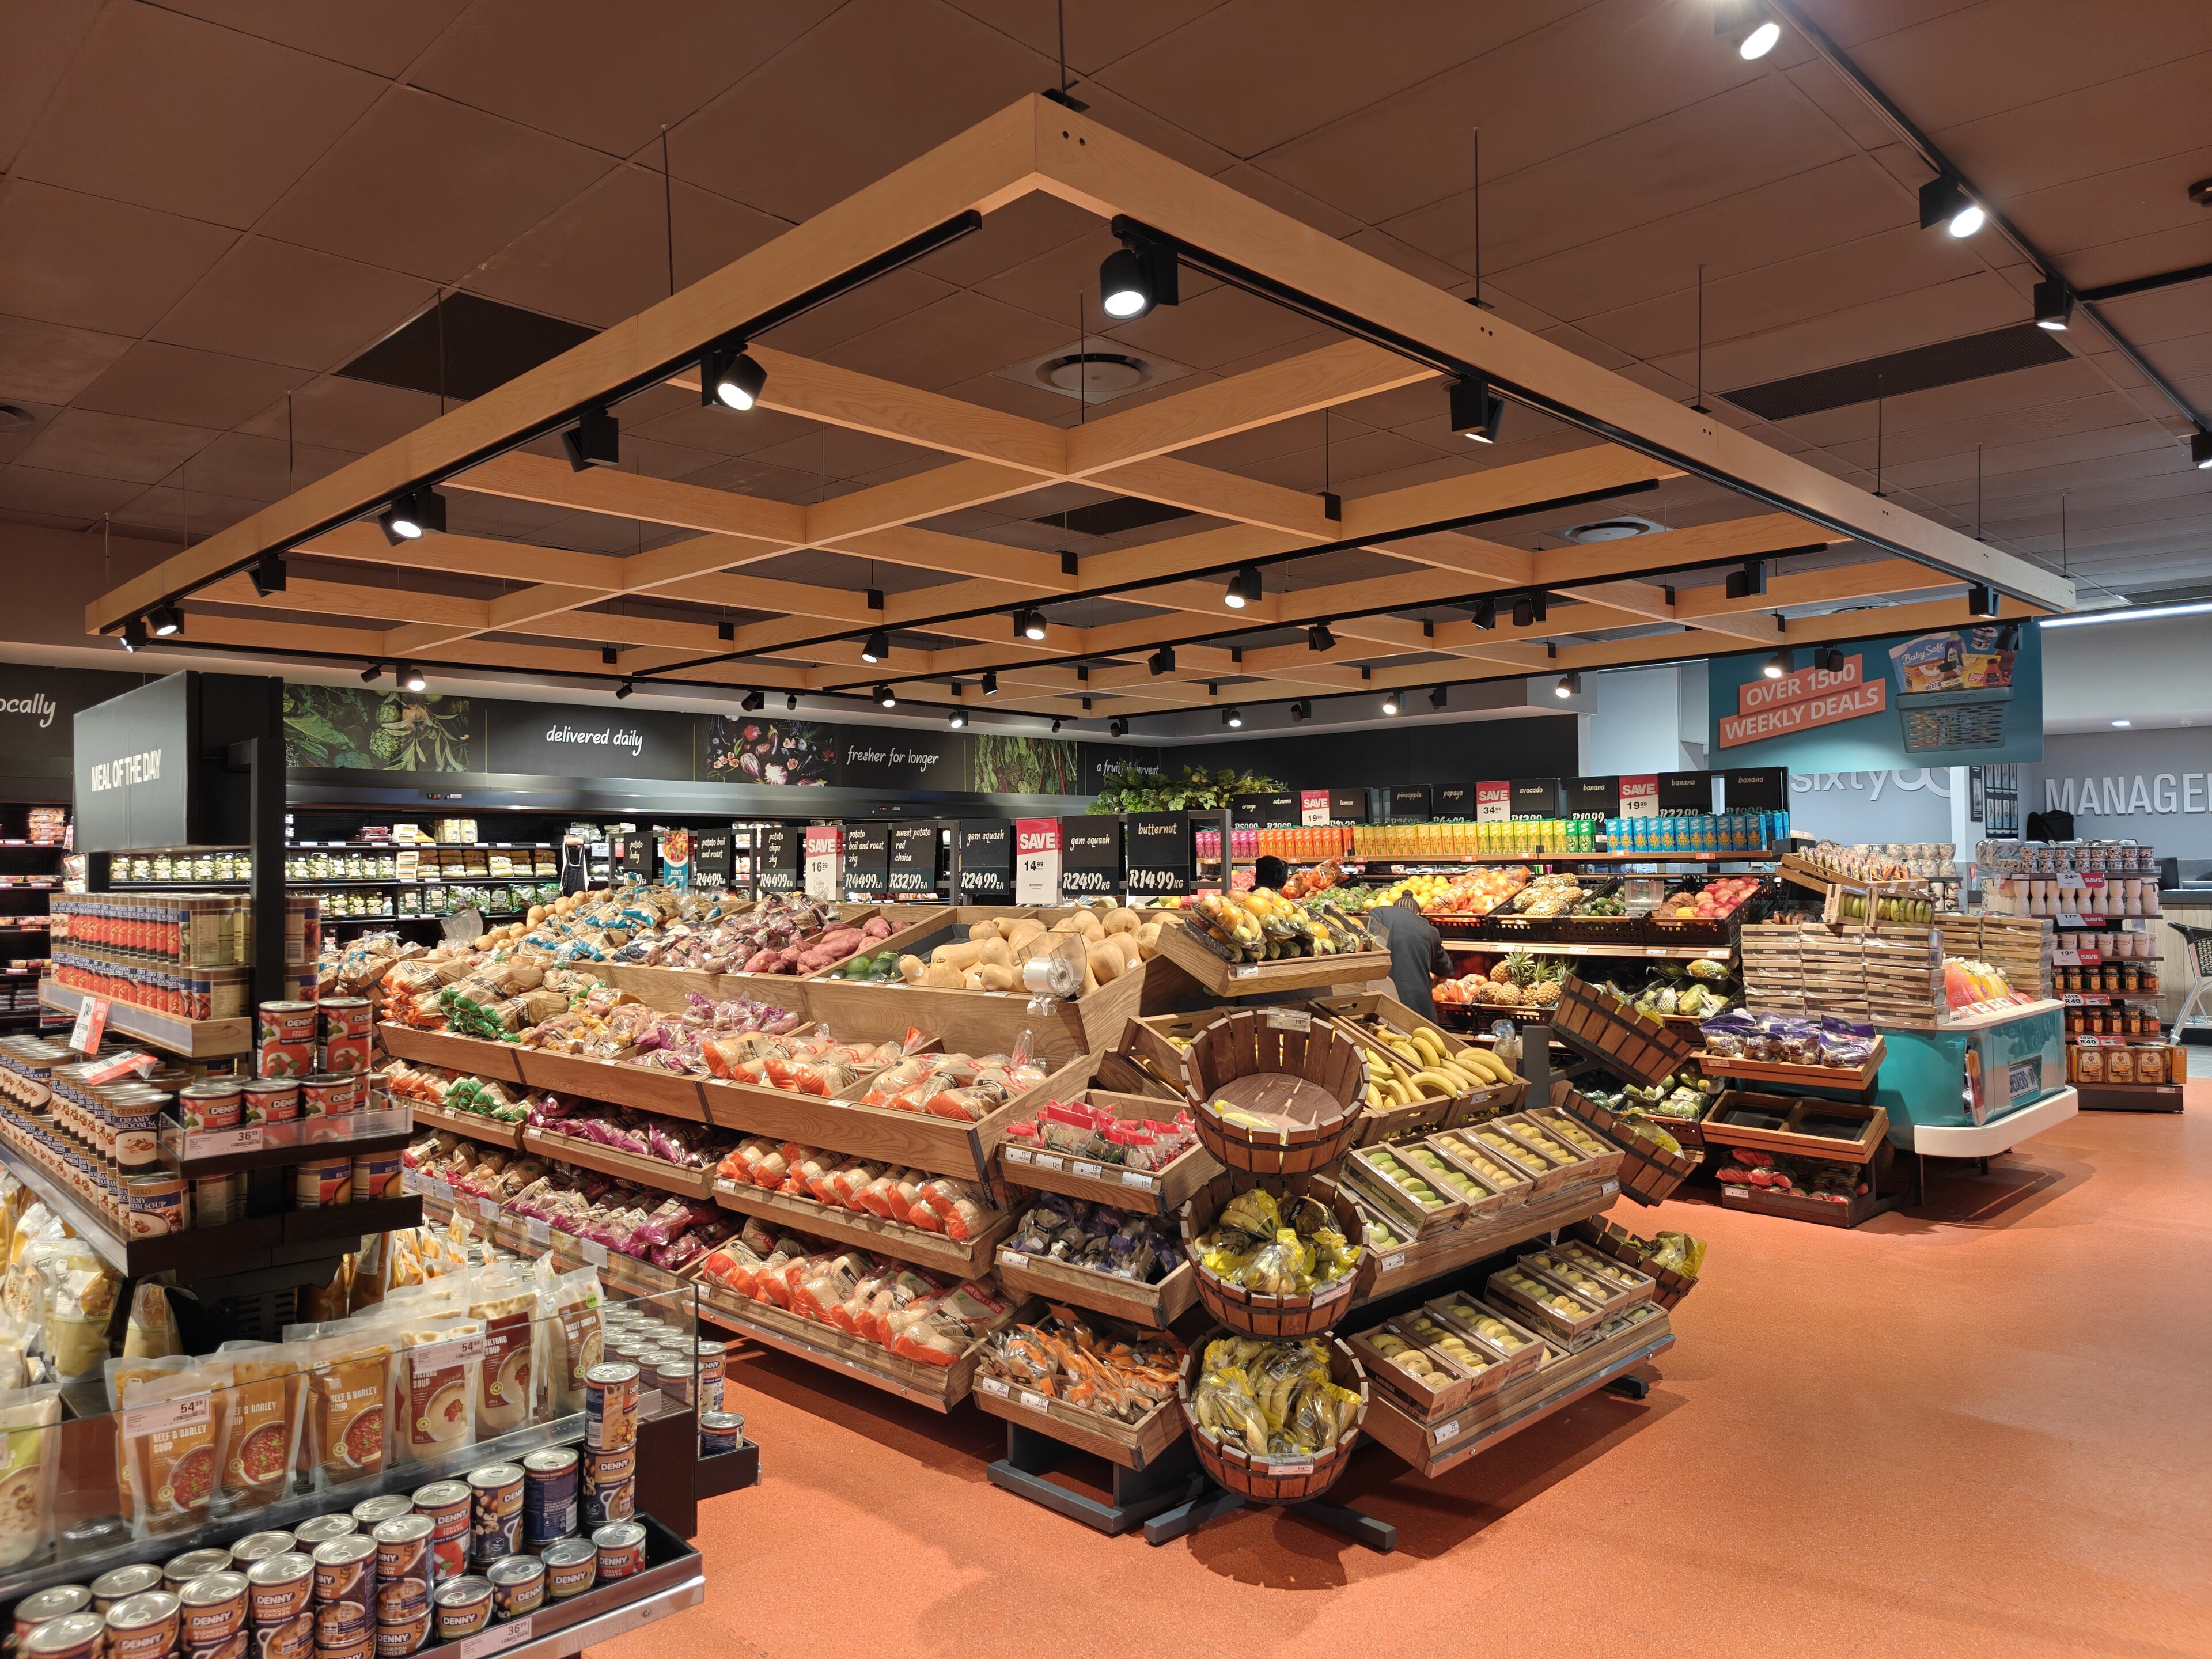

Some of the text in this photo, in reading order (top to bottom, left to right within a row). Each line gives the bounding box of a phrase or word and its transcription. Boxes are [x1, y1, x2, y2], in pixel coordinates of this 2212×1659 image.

[1902, 642, 1944, 665] Baby Soft
[1746, 664, 1855, 706] OVER 1500
[1725, 687, 1878, 740] WEEKLY DEALS
[546, 725, 643, 756] delivered daily
[846, 745, 939, 772] fresher for longer
[112, 759, 124, 789] OF
[124, 754, 142, 785] THE
[143, 749, 161, 782] DAY
[1096, 764, 1101, 772] a
[1519, 786, 1543, 794] avocado
[1583, 783, 1605, 791] banana
[1622, 783, 1656, 796] SAVE
[1397, 791, 1422, 800] pineapple
[1443, 790, 1463, 800] papaya
[1479, 790, 1508, 801] SAVE
[1303, 798, 1328, 808] SAVE
[896, 827, 931, 839] sweet potato
[1138, 823, 1177, 836] butternut
[768, 832, 784, 843] potato
[849, 830, 865, 842] potato
[966, 828, 1005, 847] gem squash
[1019, 832, 1056, 850] SAVE
[630, 840, 643, 851] potato
[701, 836, 726, 850] potato boil
[768, 843, 781, 853] chips
[808, 838, 835, 853] SAVE
[849, 840, 884, 850] boil and roast
[896, 840, 906, 850] red
[1070, 835, 1110, 851] gem squash
[630, 851, 640, 864] baby
[711, 851, 723, 859] roast
[895, 853, 912, 862] choice
[768, 855, 777, 868] 2kg
[849, 855, 858, 868] 2kg
[287, 1018, 313, 1027] DENNY
[273, 1098, 298, 1108] DENNY
[211, 1104, 239, 1115] DENNY
[119, 1115, 151, 1124] CREAMY
[143, 1200, 166, 1209] SOUP
[987, 1301, 1002, 1313] SAVE
[485, 1335, 507, 1347] BILTONG
[567, 1331, 579, 1340] SOUP
[485, 1346, 501, 1355] SOUP
[413, 1378, 430, 1388] SOUP
[330, 1392, 345, 1402] BEEF
[353, 1386, 377, 1399] BARLEY
[251, 1401, 276, 1414] BARLEY
[330, 1402, 347, 1412] SOUP
[153, 1432, 171, 1442] BEEF
[179, 1424, 207, 1437] BARLEY
[153, 1441, 173, 1453] SOUP
[601, 1459, 630, 1471] DENNY
[438, 1508, 467, 1525] DENNY
[599, 1555, 628, 1566] DENNY
[555, 1571, 586, 1584] DENNY
[257, 1592, 293, 1604] DENNY
[518, 1584, 543, 1602] DENNY
[193, 1611, 230, 1626] DENNY
[443, 1613, 476, 1626] DENNY
[122, 1633, 162, 1650] DENNY
[378, 1633, 409, 1643] DENNY
